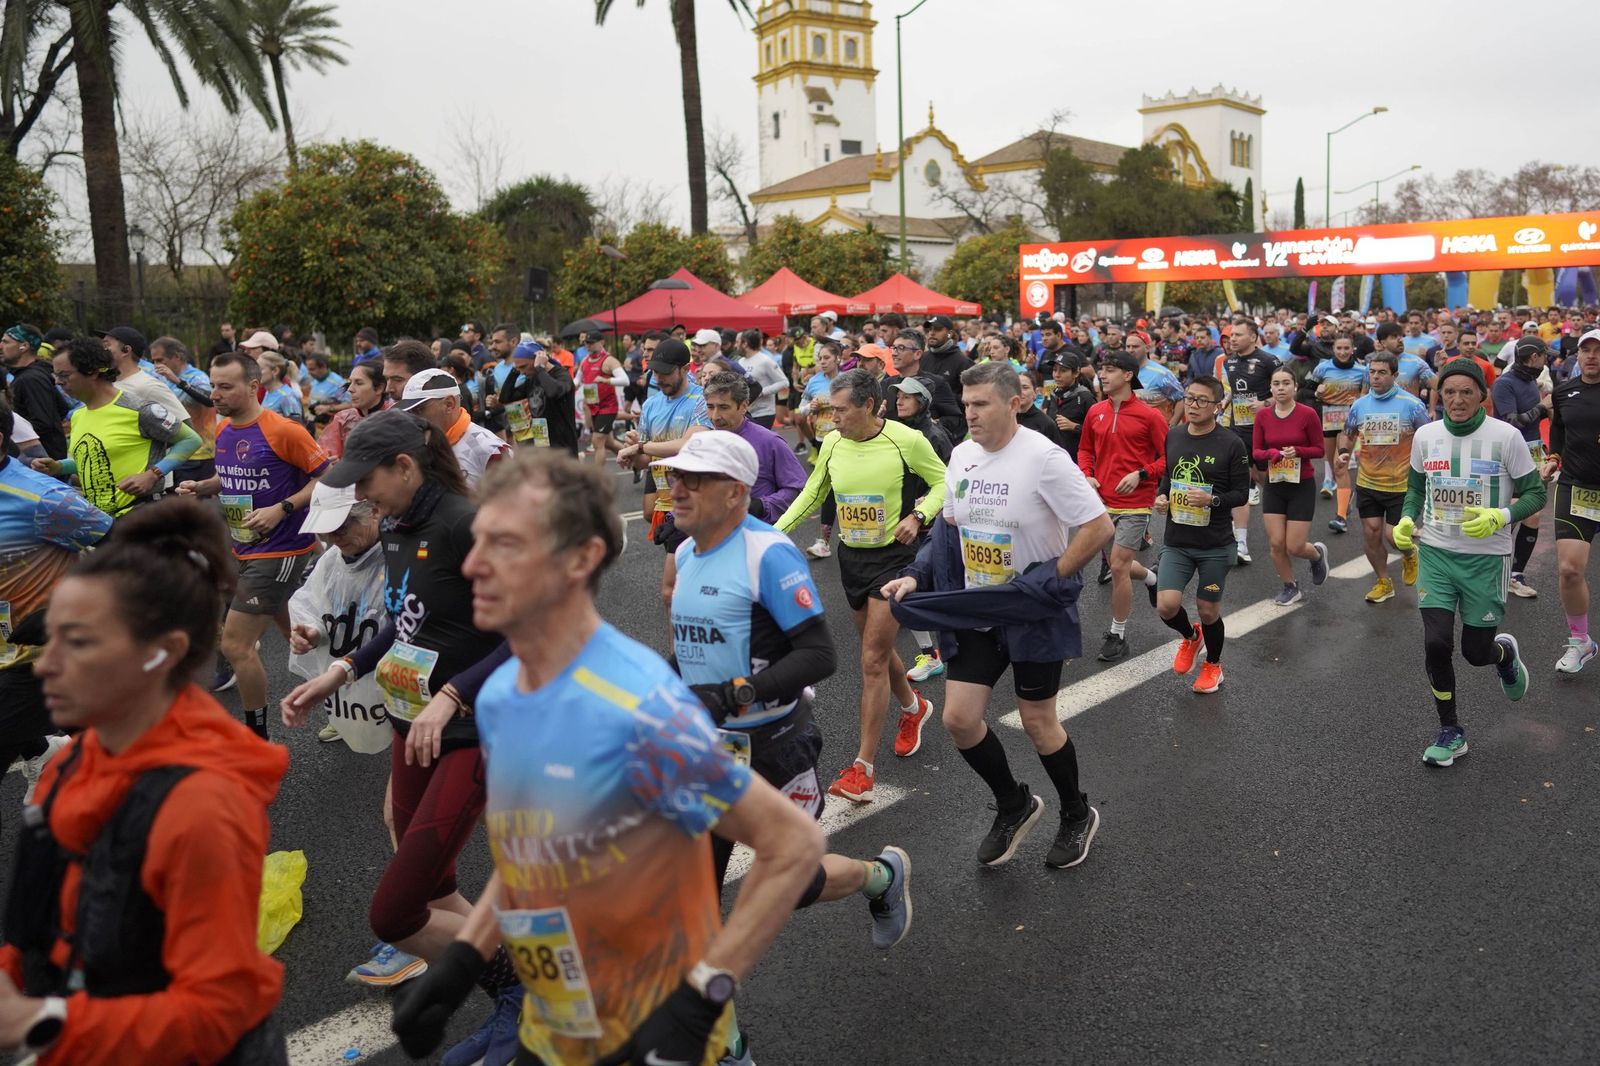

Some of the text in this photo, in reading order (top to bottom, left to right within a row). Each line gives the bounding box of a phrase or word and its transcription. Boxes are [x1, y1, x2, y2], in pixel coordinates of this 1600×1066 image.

[1366, 422, 1393, 431] 22182
[1204, 456, 1216, 464] 24
[227, 464, 270, 477] MÉDULA
[235, 478, 271, 491] VIDA
[970, 479, 1009, 496] Plena
[968, 494, 1008, 507] inclusión
[1433, 488, 1475, 505] 20015
[840, 505, 877, 522] 13450
[968, 506, 995, 518] Xerez
[968, 515, 1020, 529] Extremadura
[965, 542, 1002, 566] 15693
